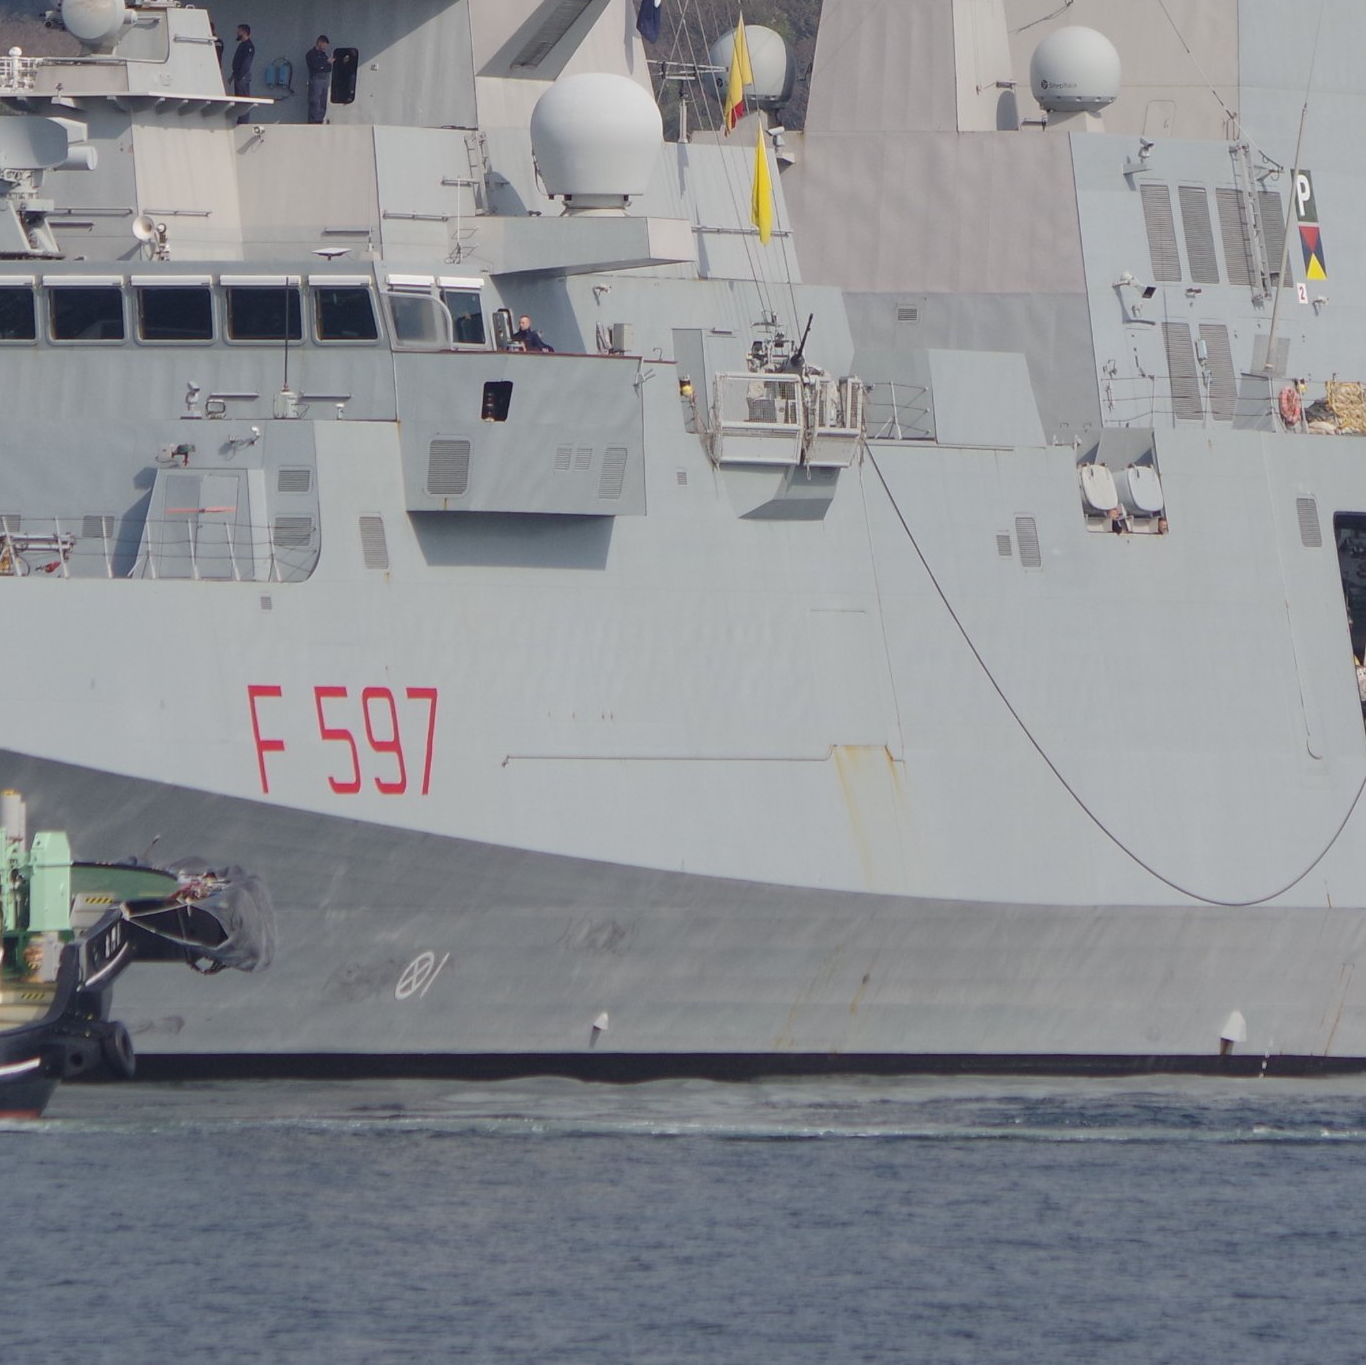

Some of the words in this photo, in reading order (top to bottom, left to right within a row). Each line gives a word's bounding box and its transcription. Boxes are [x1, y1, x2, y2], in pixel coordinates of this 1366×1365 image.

[1296, 174, 1311, 216] P
[1298, 285, 1306, 301] 2
[247, 685, 285, 794] F
[313, 686, 438, 795] 597
